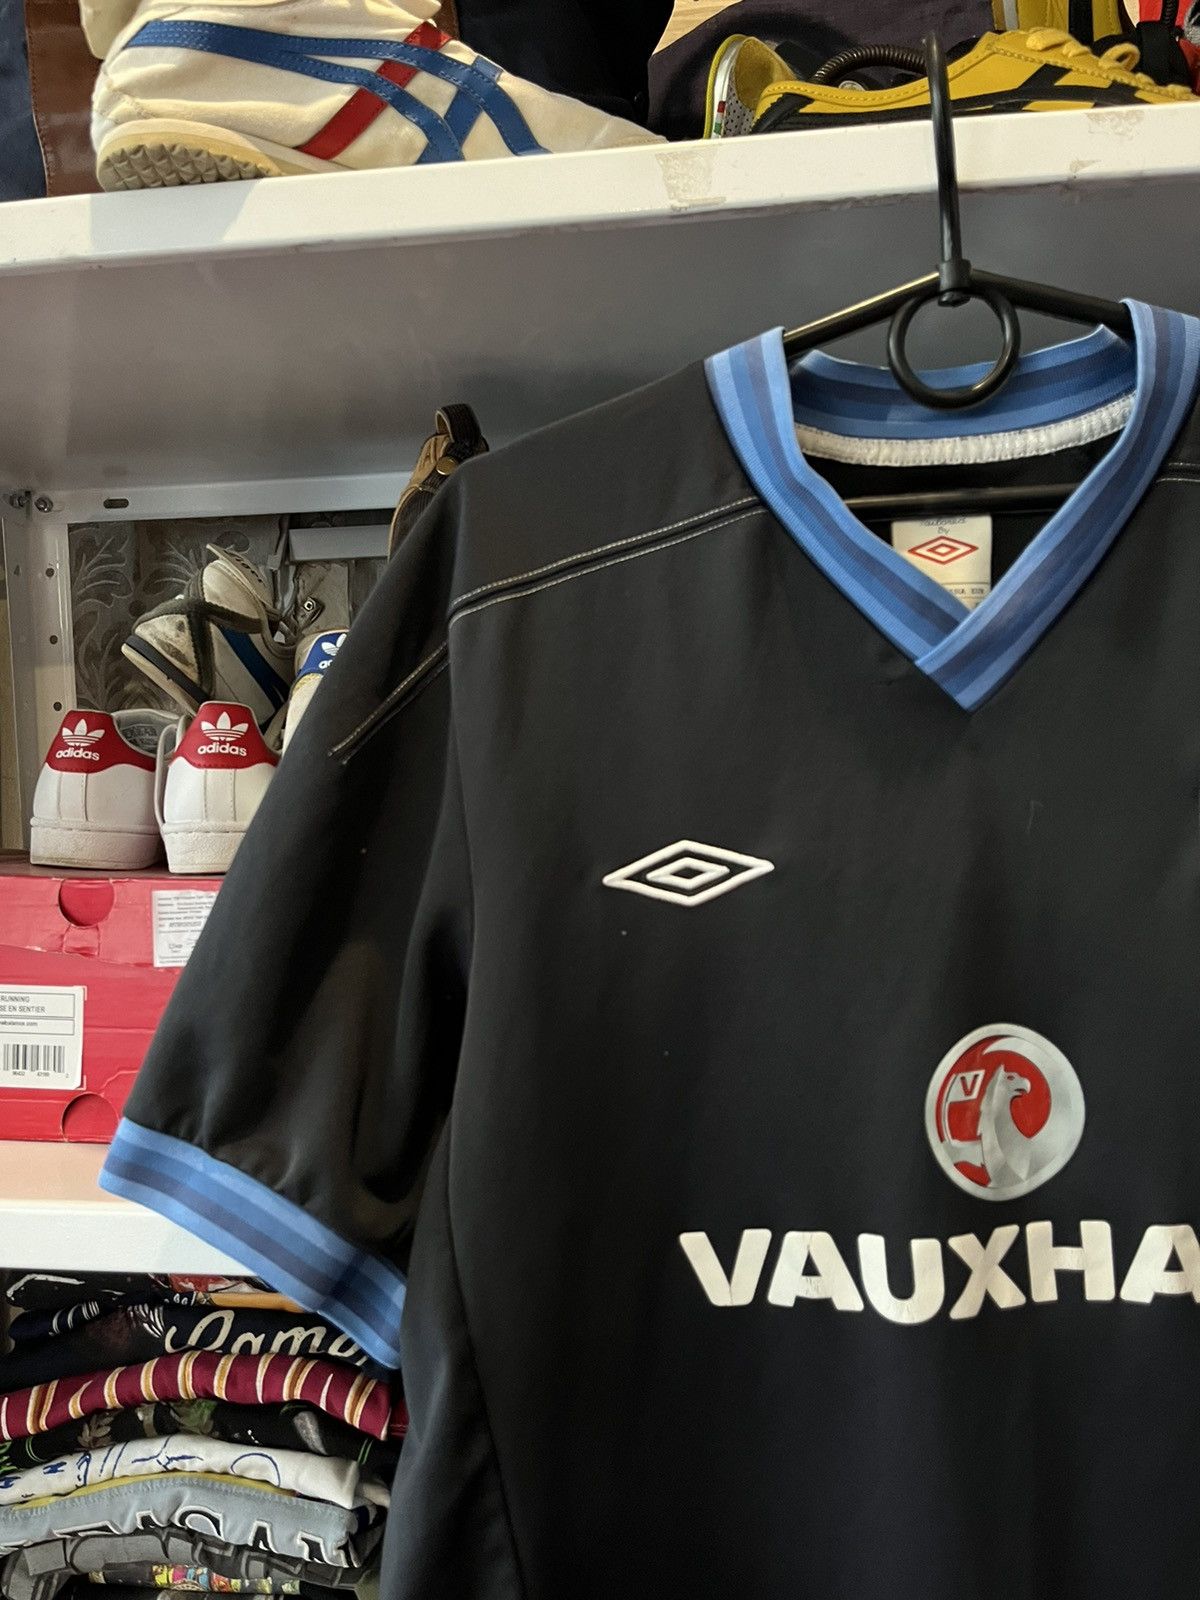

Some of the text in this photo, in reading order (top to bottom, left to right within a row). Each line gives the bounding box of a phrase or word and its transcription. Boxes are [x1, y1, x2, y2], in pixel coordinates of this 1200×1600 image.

[56, 747, 100, 761] adidas
[197, 742, 247, 756] adidas
[960, 1073, 979, 1097] V
[679, 1220, 1200, 1325] VAUXHA
